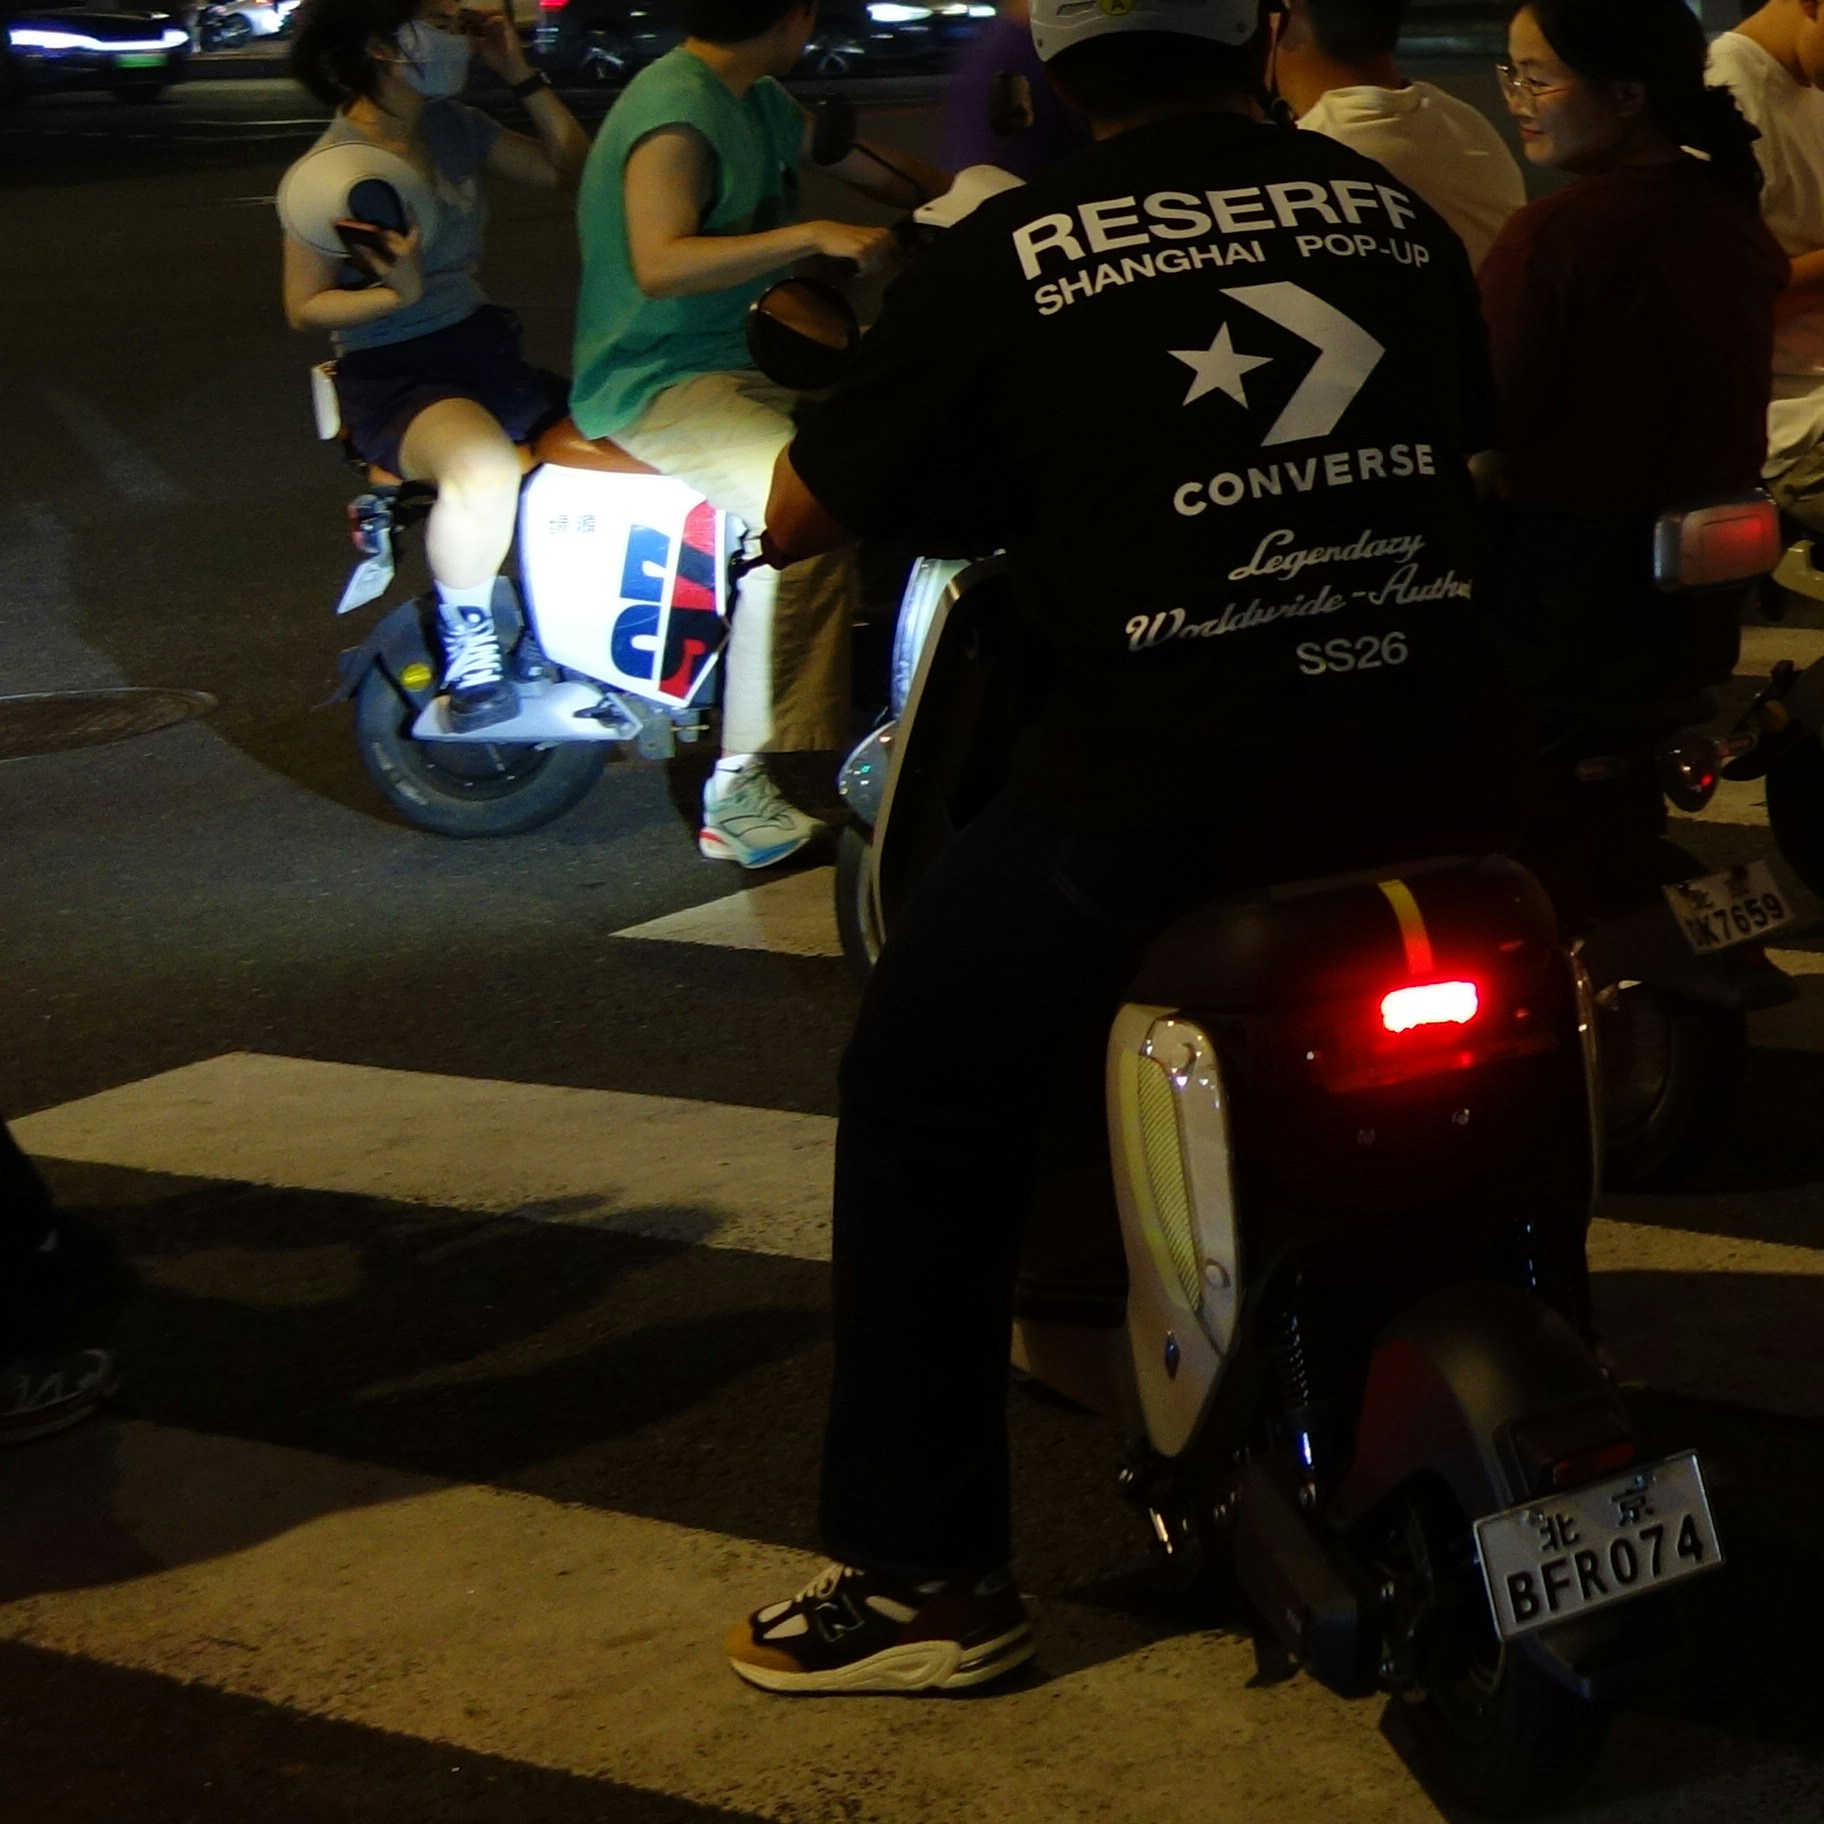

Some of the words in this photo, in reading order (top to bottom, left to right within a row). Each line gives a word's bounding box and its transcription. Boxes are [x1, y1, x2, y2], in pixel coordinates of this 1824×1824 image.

[1012, 179, 1420, 282] RESERFF
[1034, 240, 1265, 317] SHANGHAI
[1297, 235, 1432, 270] POP-UP
[1173, 443, 1437, 517] CONVERSE
[1227, 529, 1427, 583] Legendary
[1295, 630, 1409, 677] SS26
[1537, 1488, 1656, 1552] 北京
[1506, 1513, 1705, 1624] BFR074
